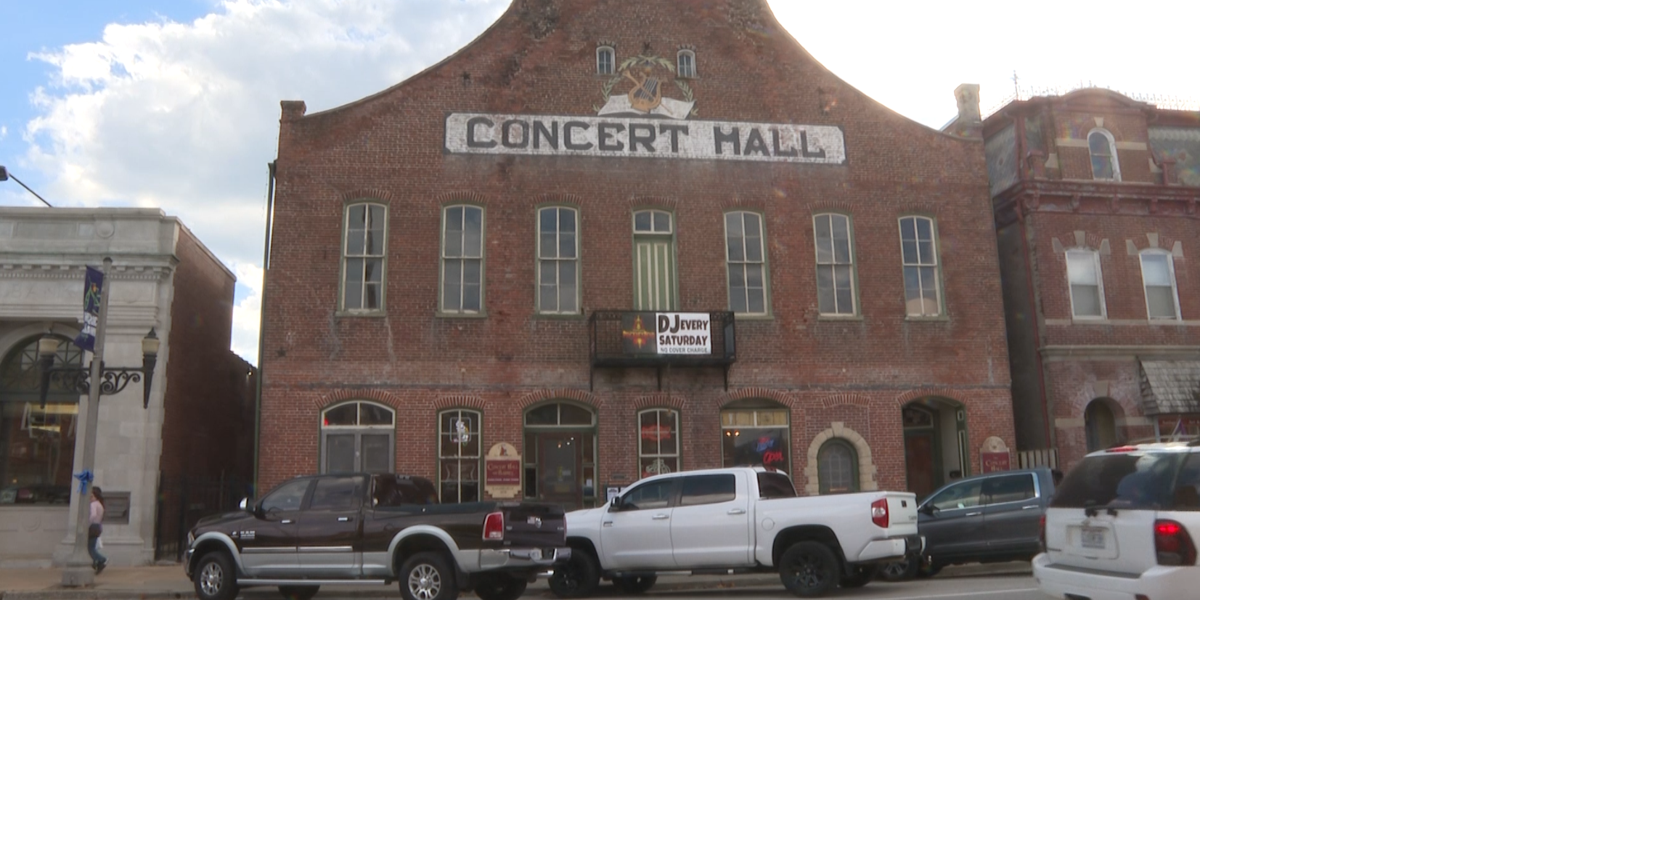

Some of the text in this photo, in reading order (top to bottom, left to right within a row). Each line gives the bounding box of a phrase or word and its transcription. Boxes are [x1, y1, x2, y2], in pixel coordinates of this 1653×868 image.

[466, 117, 825, 158] CONCERT HALL
[658, 314, 708, 333] DJ EVERY
[659, 335, 708, 346] SATURDAY
